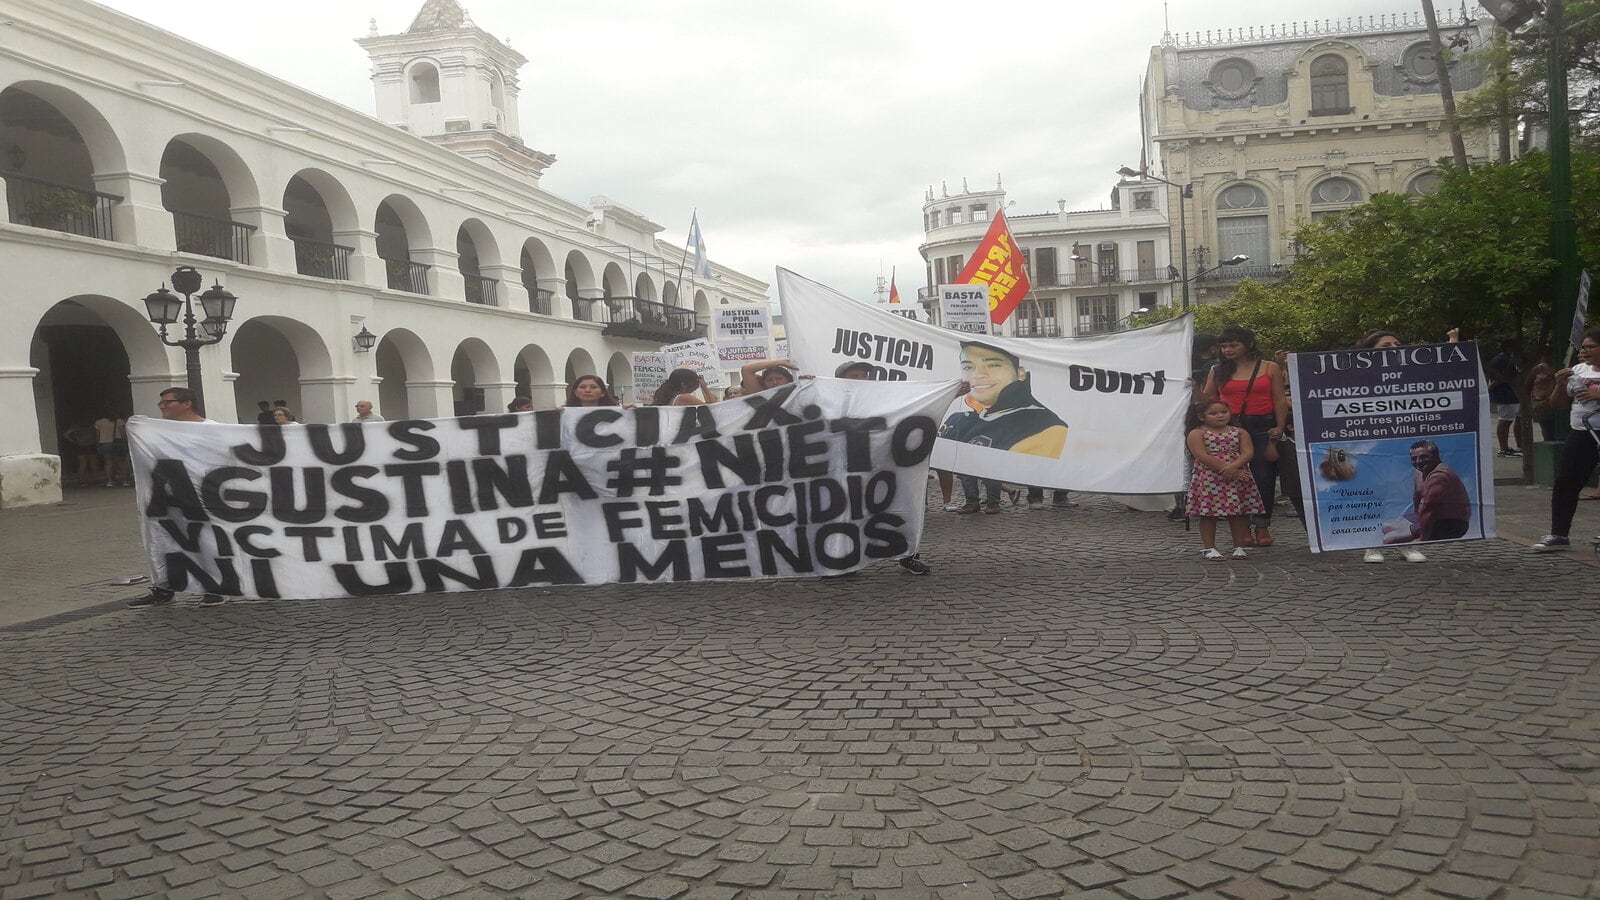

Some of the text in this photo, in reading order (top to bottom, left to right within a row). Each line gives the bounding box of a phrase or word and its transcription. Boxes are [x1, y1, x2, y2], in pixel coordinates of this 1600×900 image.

[945, 291, 983, 299] BASTA
[689, 351, 709, 359] DAVID
[832, 328, 934, 370] JUSTICIA
[634, 355, 661, 363] BASTA
[1314, 345, 1469, 375] JUSTICIA
[1382, 371, 1403, 381] por
[1308, 378, 1475, 399] ALFONZO OVEJERO DAVID
[1334, 396, 1451, 415] ASESINADO
[1345, 418, 1366, 427] por
[1369, 415, 1392, 424] tres
[233, 405, 721, 466] JUSTICIA
[1321, 422, 1465, 439] de Salta en Villa Floresta
[147, 450, 598, 524] AGUSTINA
[1328, 501, 1384, 512] por siempre
[159, 470, 896, 562] VICTIMA DE FEMICIDIO
[1343, 513, 1381, 521] nuestros
[166, 513, 909, 598] NI UNA MENOS
